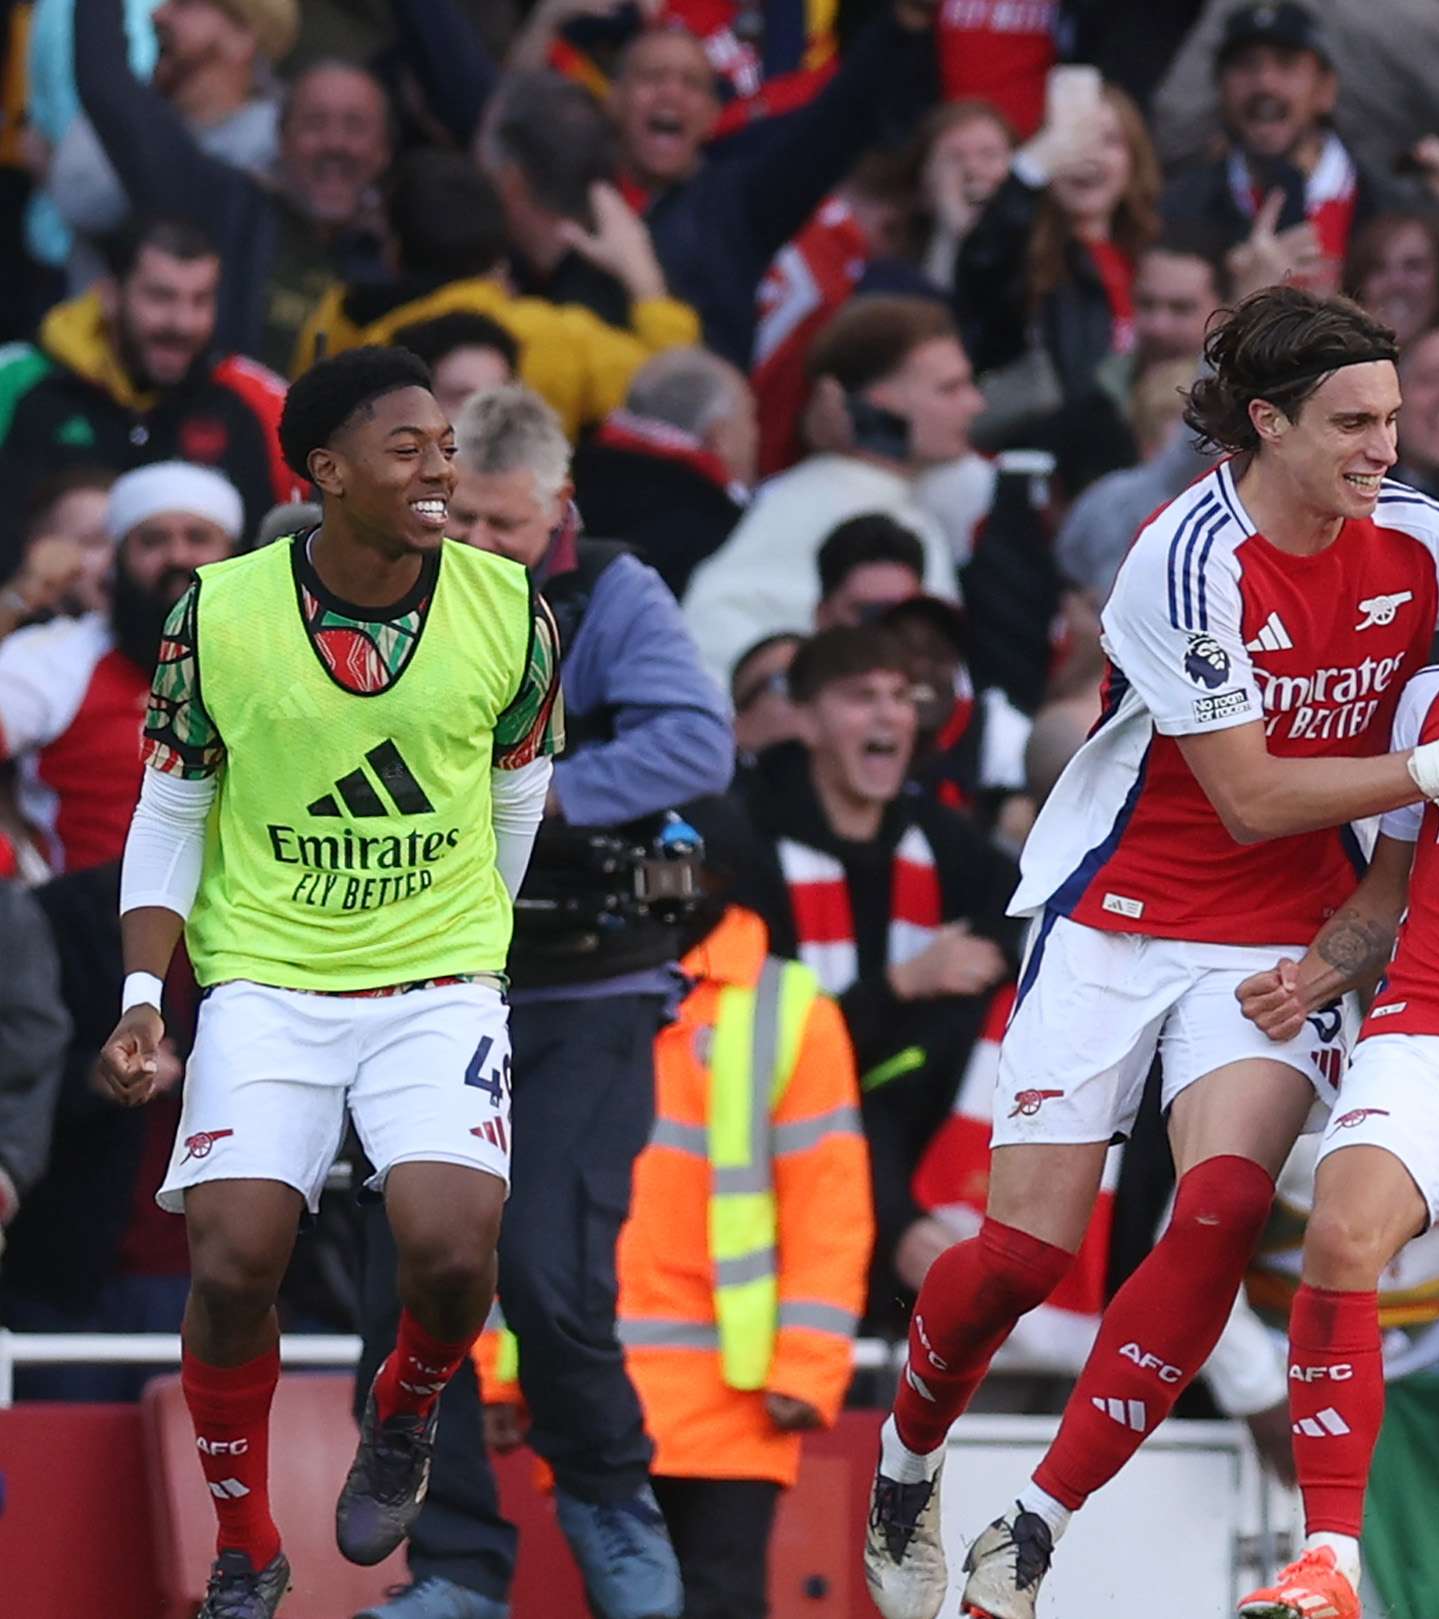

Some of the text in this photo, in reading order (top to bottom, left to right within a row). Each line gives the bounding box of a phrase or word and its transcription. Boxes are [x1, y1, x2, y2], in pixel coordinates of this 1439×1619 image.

[292, 873, 337, 907] FLY
[1119, 1342, 1183, 1383] AFC
[1290, 1364, 1353, 1383] AFC
[196, 1436, 248, 1456] AFC
